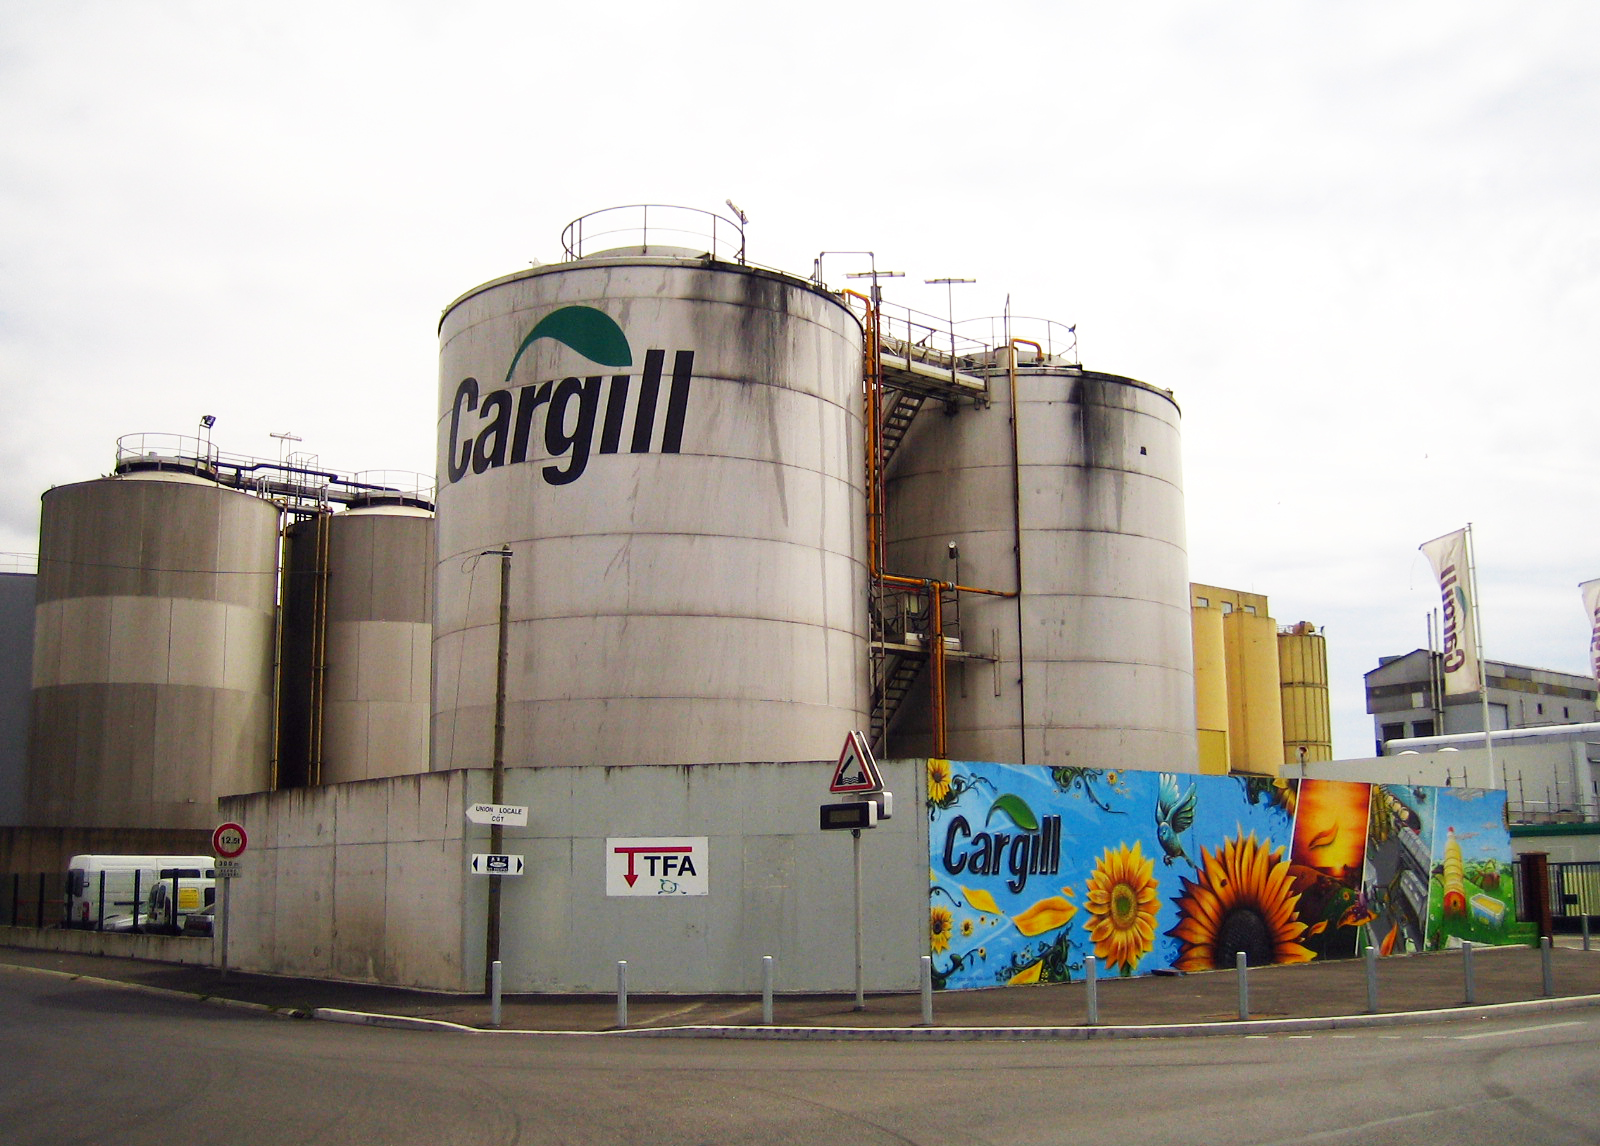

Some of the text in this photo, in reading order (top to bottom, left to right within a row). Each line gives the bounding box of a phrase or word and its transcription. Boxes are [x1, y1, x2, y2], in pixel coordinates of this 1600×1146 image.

[448, 349, 695, 486] Cargill
[475, 805, 522, 815] UNION LOCALE
[643, 855, 697, 877] TFA
[943, 814, 1061, 893] Cargill
